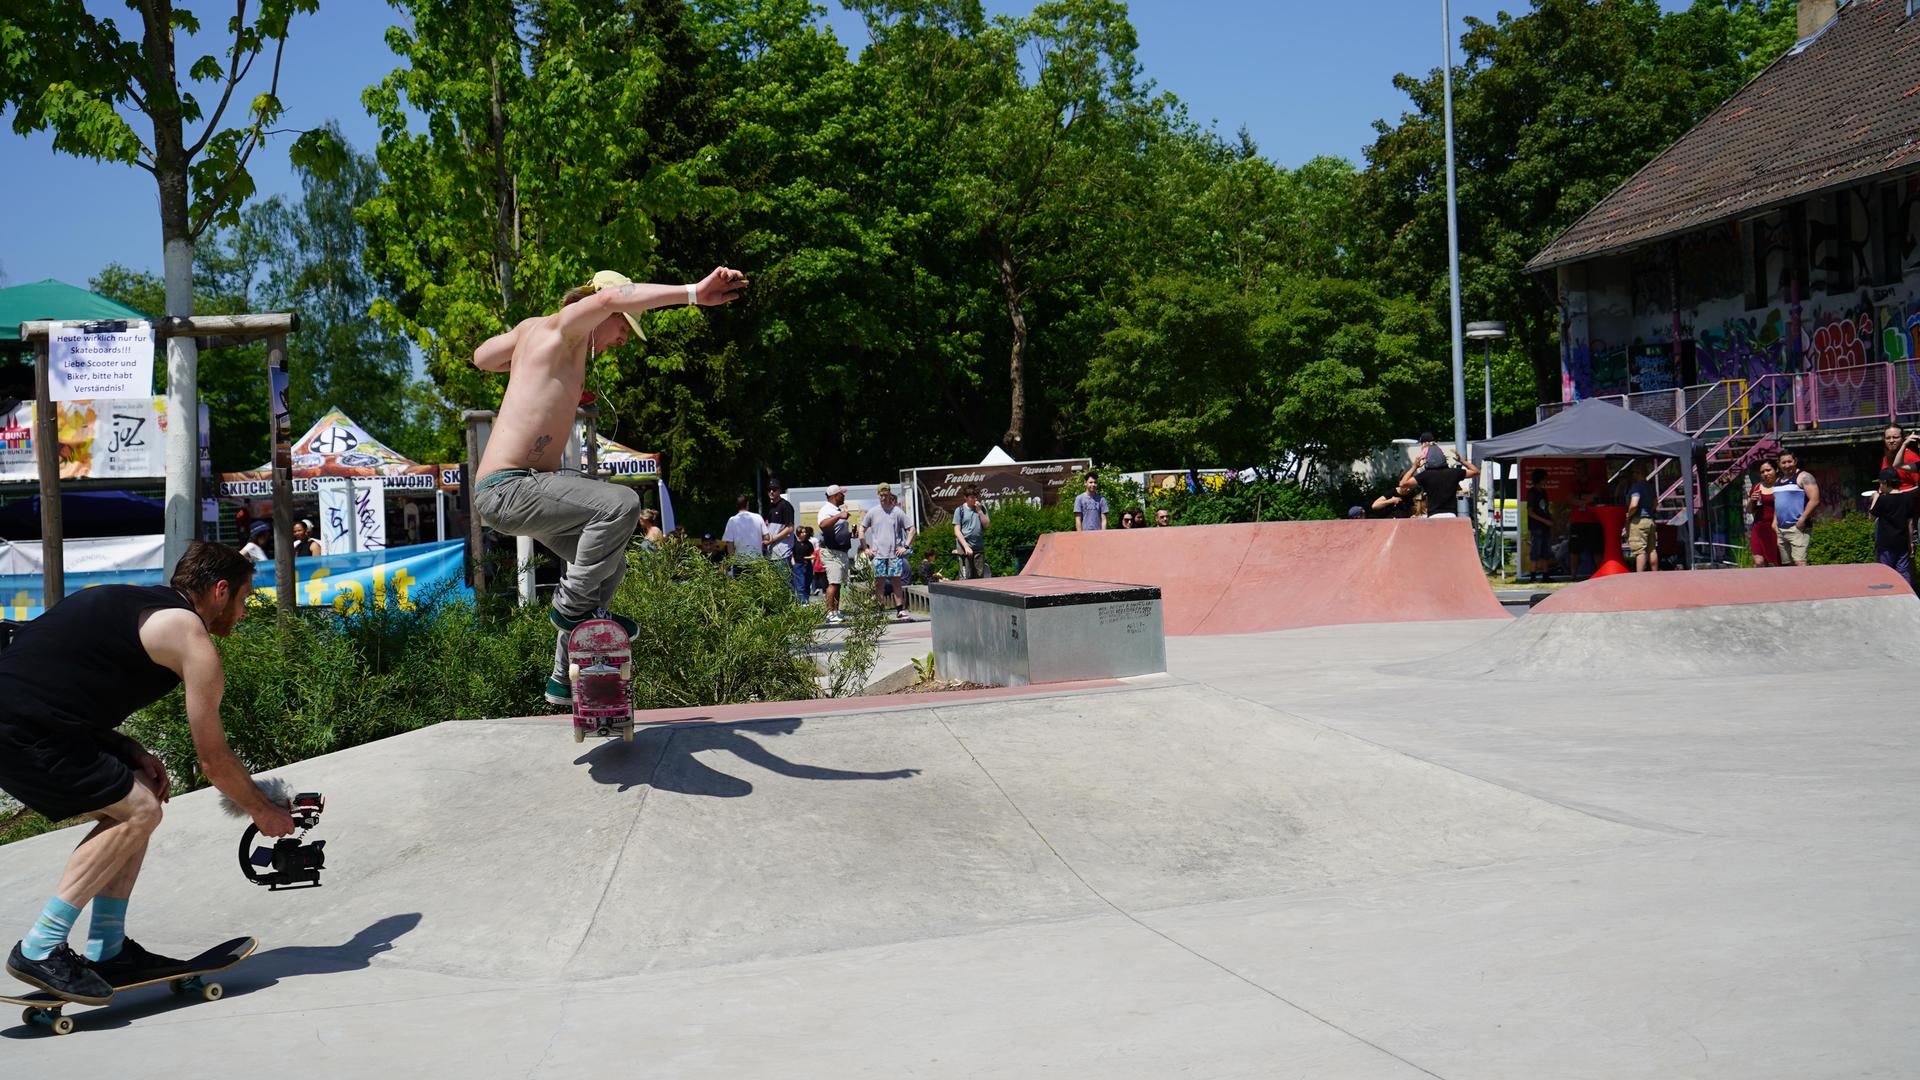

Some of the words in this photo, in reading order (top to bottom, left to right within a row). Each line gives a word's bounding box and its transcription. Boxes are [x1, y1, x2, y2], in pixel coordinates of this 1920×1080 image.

[84, 334, 116, 342] wirklich
[70, 346, 131, 354] Skateboards!!!
[64, 360, 85, 368] Liebe
[92, 372, 111, 380] bitte
[944, 473, 986, 484] Pastabox
[220, 481, 267, 496] SKITCH
[931, 485, 961, 498] Salat
